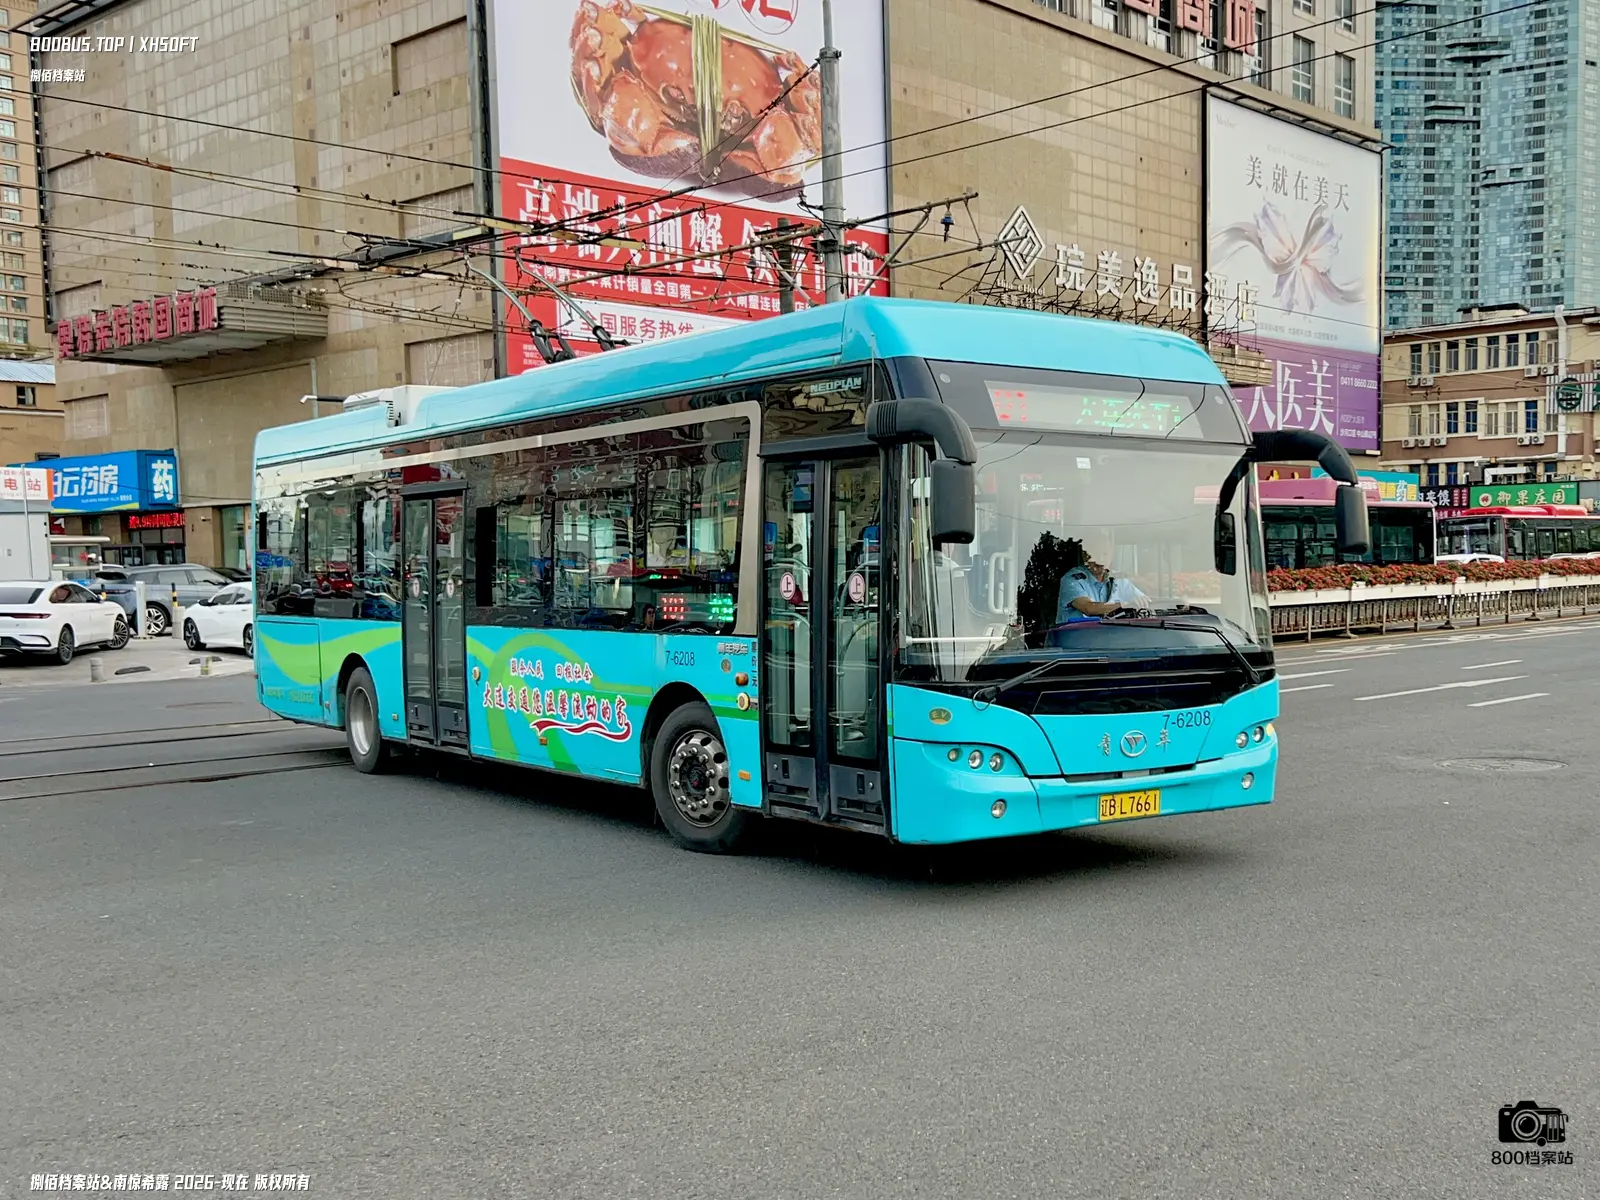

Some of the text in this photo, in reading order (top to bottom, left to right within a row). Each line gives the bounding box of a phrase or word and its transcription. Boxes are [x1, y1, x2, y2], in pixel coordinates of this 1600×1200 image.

[810, 377, 862, 393] NEOPLAN
[151, 459, 174, 501] 药
[665, 650, 695, 666] 7-6208
[1162, 710, 1211, 730] 7-6208
